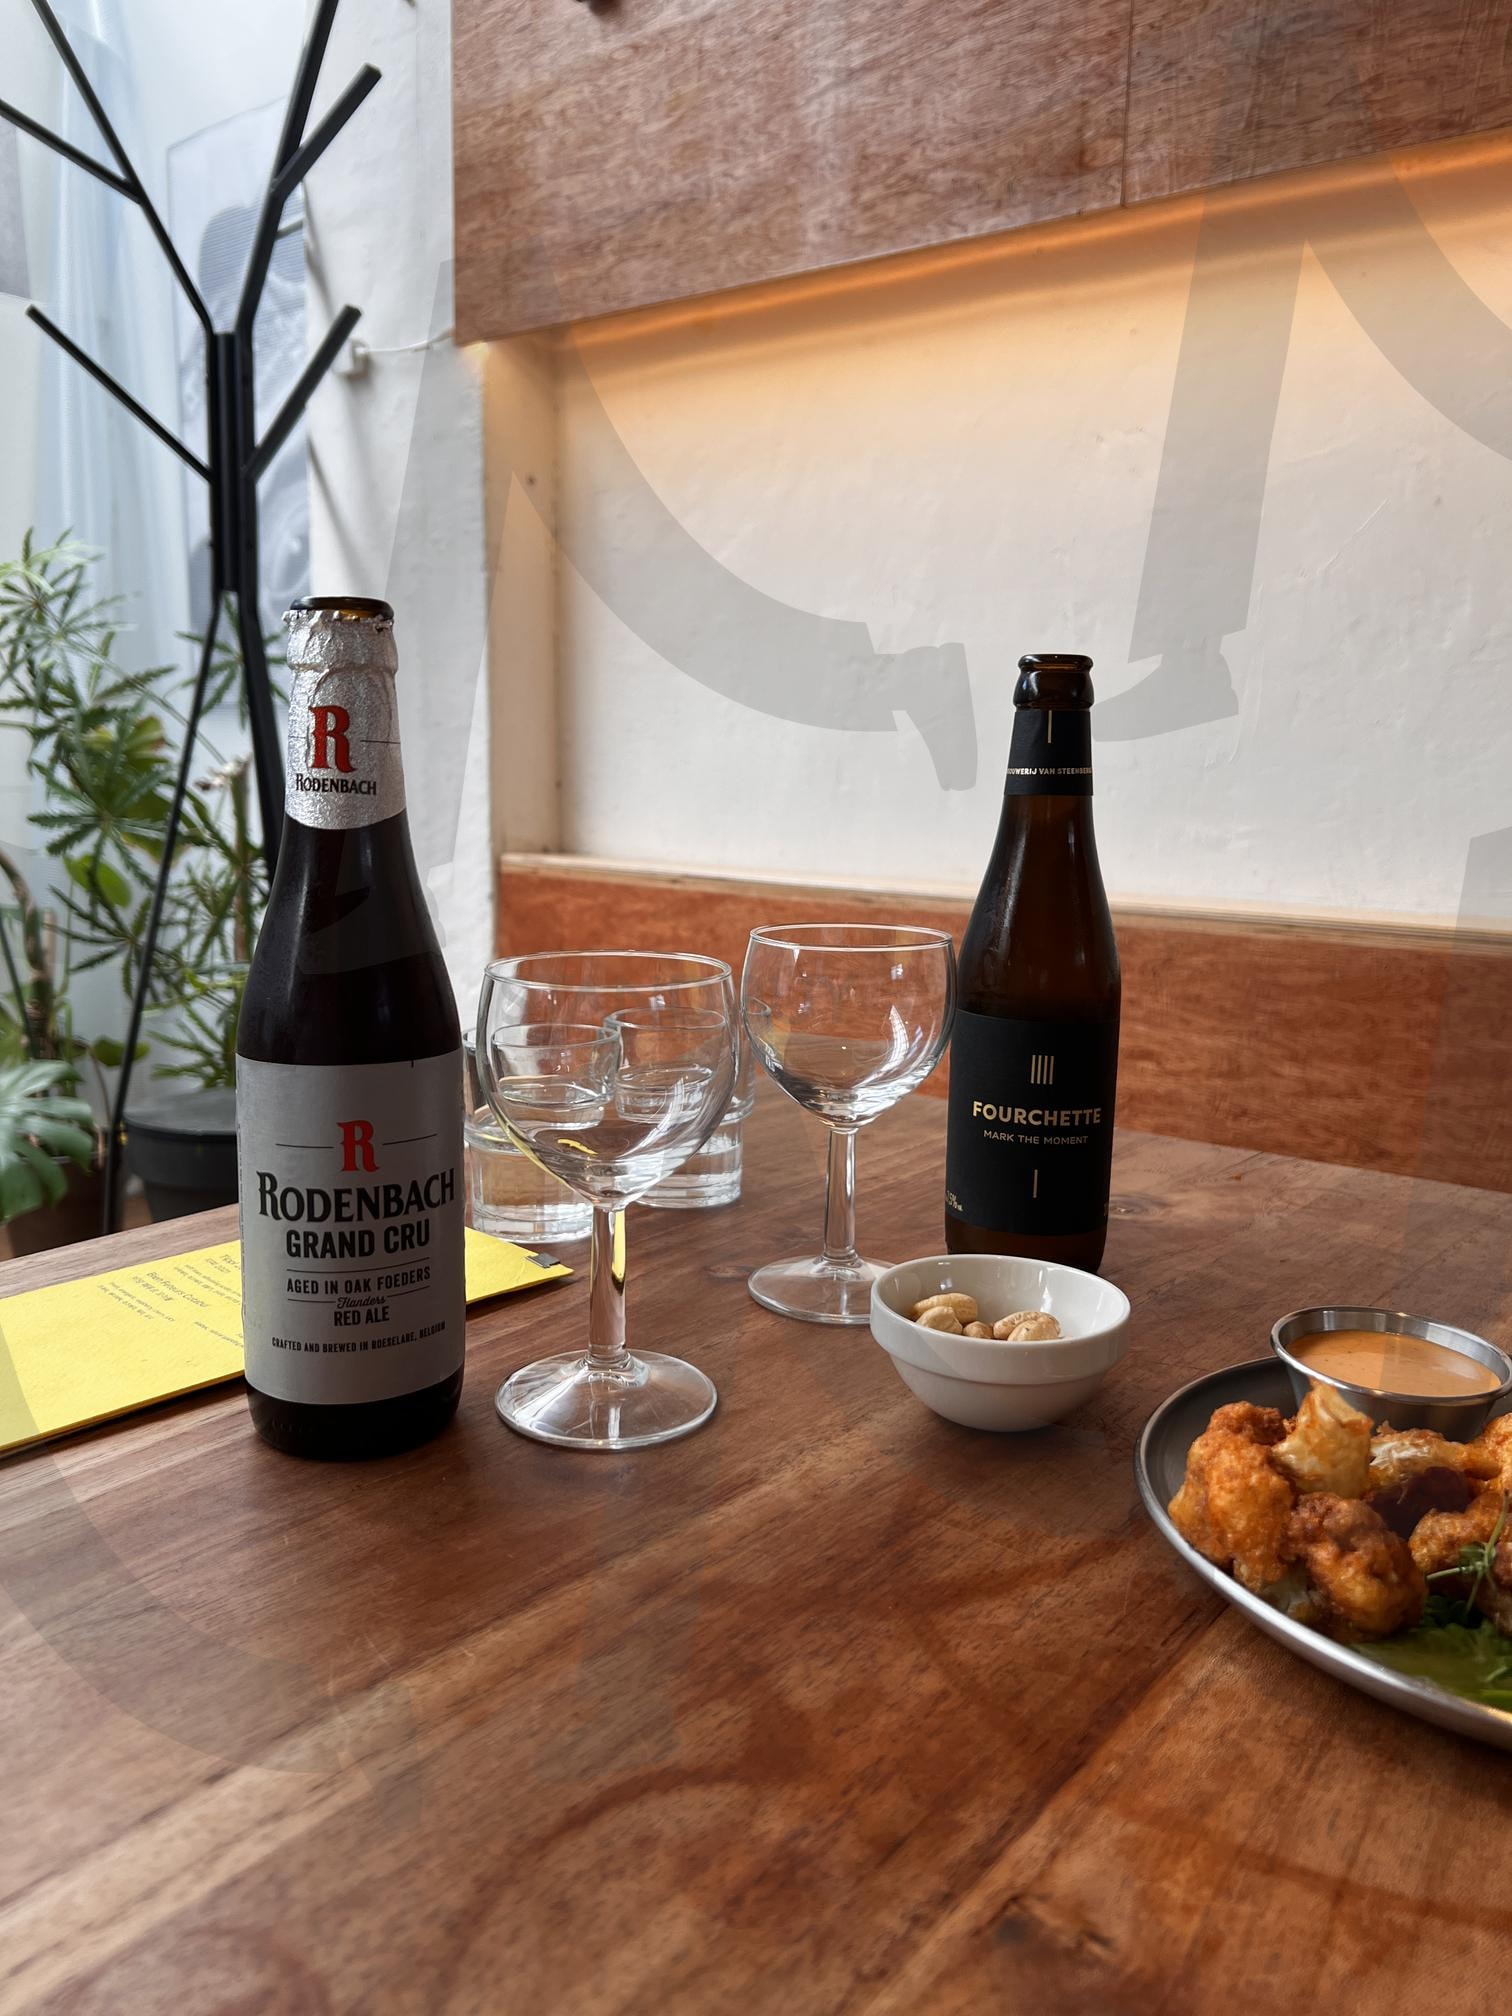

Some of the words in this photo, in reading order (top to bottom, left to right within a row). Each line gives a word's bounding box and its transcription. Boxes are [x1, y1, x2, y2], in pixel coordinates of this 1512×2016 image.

[308, 705, 357, 773] R
[1039, 767, 1055, 775] VAN
[972, 1101, 1101, 1126] FOURCHETTE
[336, 1120, 380, 1172] R
[984, 1129, 1014, 1142] MARK
[1018, 1134, 1040, 1144] THE
[1043, 1135, 1088, 1144] MOMENT
[286, 1229, 375, 1258] GRAND
[384, 1219, 429, 1253] CRU
[287, 1278, 319, 1294] AGED
[325, 1280, 338, 1294] IN
[345, 1278, 371, 1293] OAK
[377, 1266, 430, 1290] FOEDERS
[337, 1295, 386, 1309] Flanders
[334, 1310, 361, 1327] RED
[365, 1306, 390, 1324] ALE
[272, 1337, 302, 1351] CRAFTED
[304, 1342, 320, 1353] AND
[323, 1342, 357, 1353] BREWED
[360, 1340, 369, 1351] IN
[419, 1320, 446, 1339] BELGIUM
